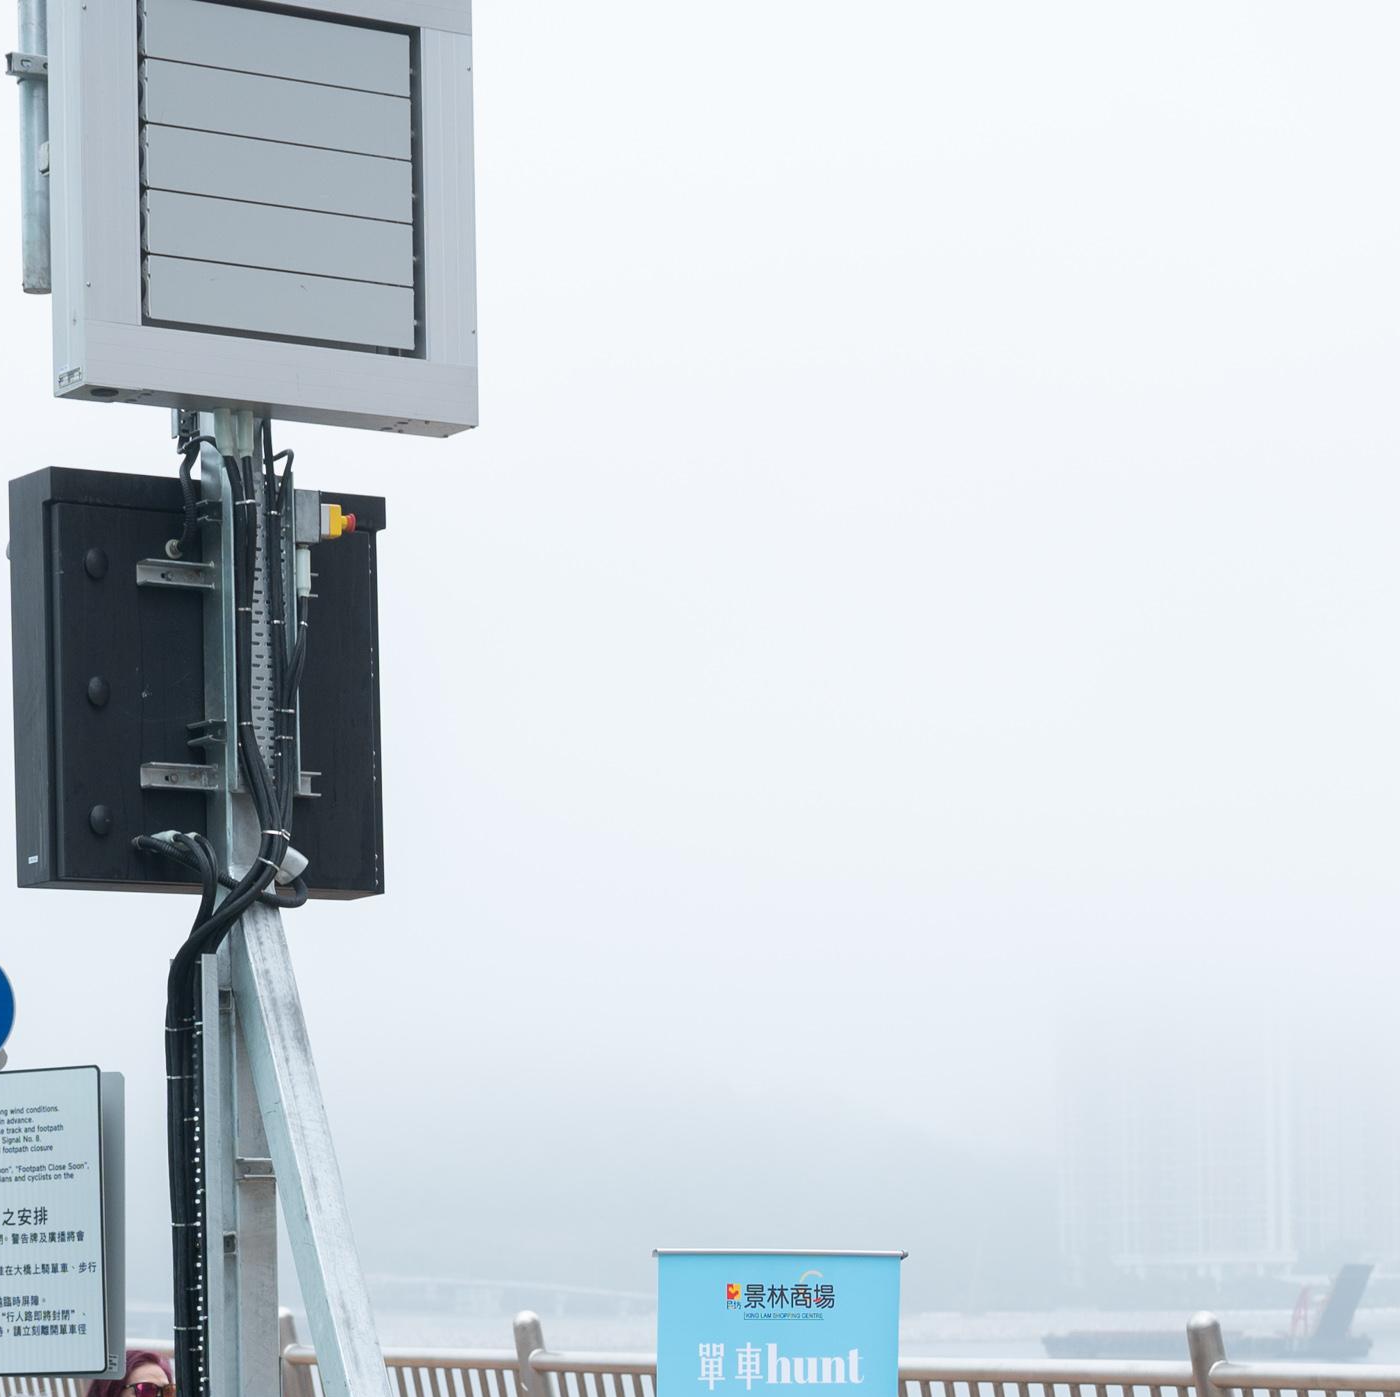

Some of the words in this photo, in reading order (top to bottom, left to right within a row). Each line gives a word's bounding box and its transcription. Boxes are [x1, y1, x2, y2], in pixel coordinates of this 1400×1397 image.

[37, 1125, 64, 1134] footpath
[2, 1137, 21, 1146] Signal
[2, 1146, 29, 1156] footpath
[28, 1174, 52, 1183] cyclists
[744, 1284, 835, 1309] 景林商場
